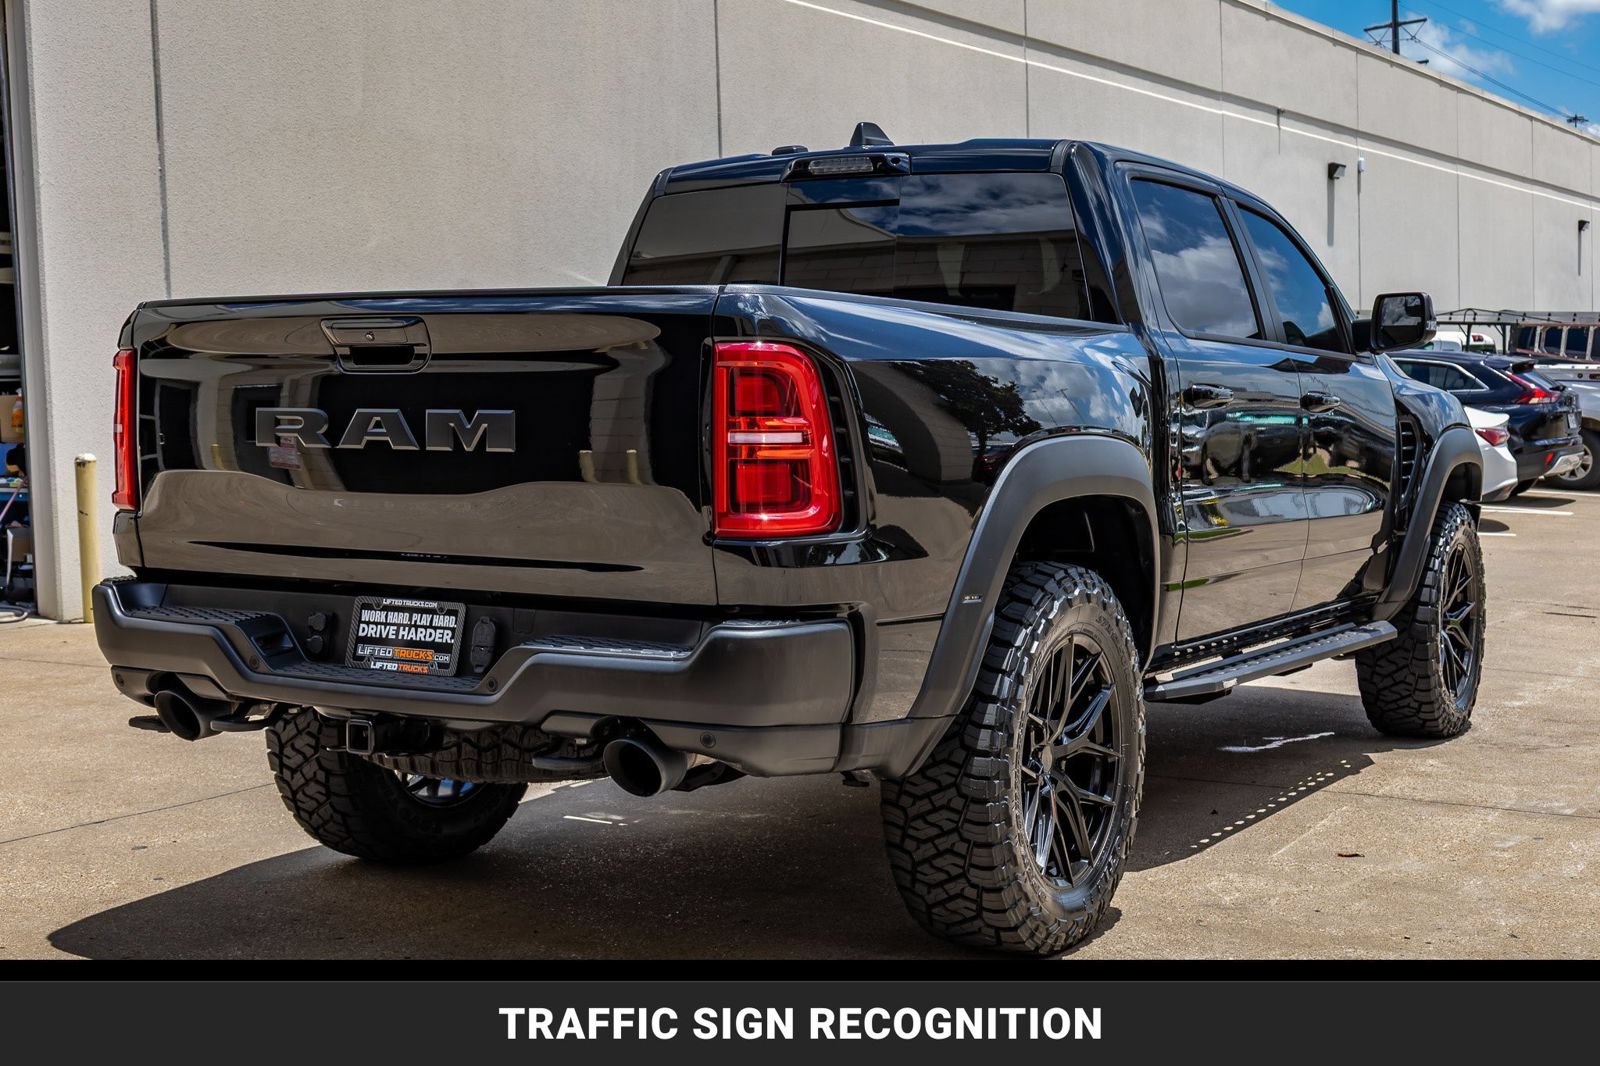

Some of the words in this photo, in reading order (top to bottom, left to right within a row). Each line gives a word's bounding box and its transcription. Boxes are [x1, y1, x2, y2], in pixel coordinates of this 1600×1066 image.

[256, 407, 516, 452] RAM
[361, 610, 387, 622] WORK
[387, 612, 410, 624] HARD.
[411, 614, 432, 626] PLAY
[433, 615, 457, 627] HARD.
[358, 624, 397, 638] DRIVE
[398, 627, 455, 643] HARDER.
